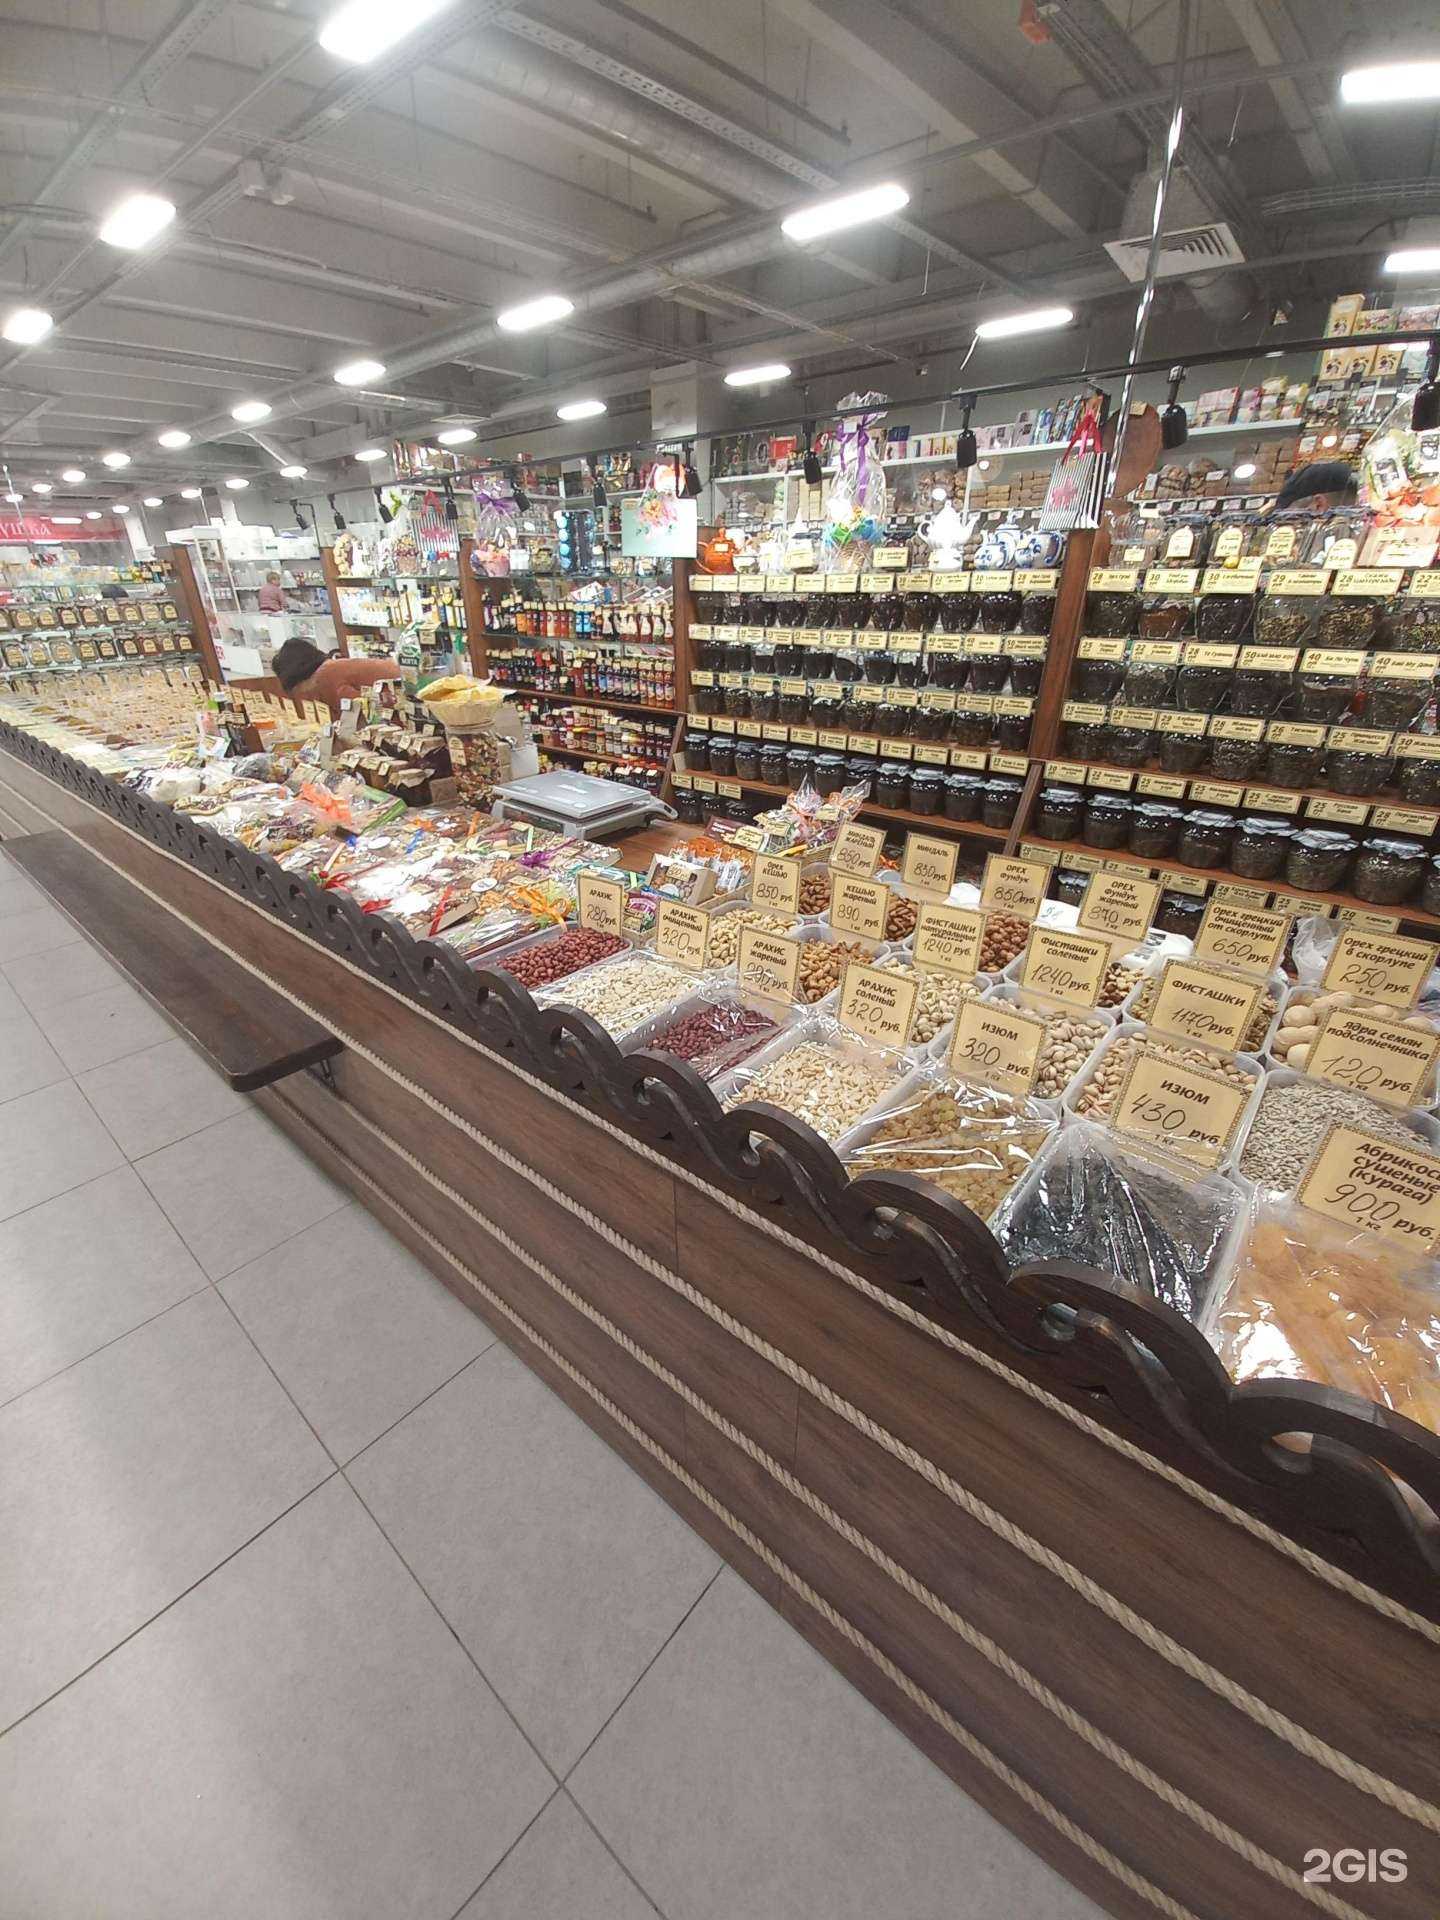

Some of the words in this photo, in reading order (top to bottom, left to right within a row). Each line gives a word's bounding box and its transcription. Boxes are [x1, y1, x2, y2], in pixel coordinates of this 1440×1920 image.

[1272, 574, 1286, 582] 29
[1417, 574, 1431, 582] 22
[1308, 653, 1322, 661] 40
[1400, 738, 1413, 746] 30
[1376, 811, 1391, 819] 28
[762, 868, 788, 880] КЕШЬЮ
[1006, 864, 1027, 875] ОРЕХ
[589, 888, 613, 901] АРАХИС
[756, 883, 779, 900] 850
[780, 894, 793, 904] руб.
[846, 885, 876, 898] КЕШЬЮ
[1111, 880, 1136, 892] ОРЕХ
[1020, 896, 1037, 905] руб.
[586, 903, 607, 924] 280
[670, 908, 698, 923] АРАХИС
[837, 904, 860, 922] 890
[864, 918, 880, 929] руб.
[1123, 917, 1143, 927] руб.
[1213, 906, 1238, 919] Орех
[1240, 911, 1284, 927] грецкий
[925, 917, 977, 935] ФИСТАШКИ
[1207, 922, 1223, 932] от
[1224, 925, 1277, 943] скорлупы
[662, 927, 690, 951] 320
[753, 940, 786, 956] АРАХИС
[922, 938, 951, 955] 1240
[952, 948, 972, 957] руб.
[1040, 936, 1099, 956] Фисташки
[750, 950, 787, 967] жареный
[1046, 947, 1089, 964] соленые
[1212, 938, 1253, 958] 650
[1248, 953, 1271, 965] руб.
[1344, 937, 1375, 951] Орех
[1376, 944, 1428, 962] грецкий
[1346, 948, 1354, 957] в
[1356, 952, 1416, 970] скорлупе
[771, 979, 789, 991] руб.
[1031, 963, 1072, 988] 1240
[1069, 980, 1091, 992] руб.
[1339, 964, 1388, 989] 250
[1384, 982, 1411, 995] руб.
[855, 988, 897, 1008] соленый
[858, 978, 898, 998] АРАХИС
[1172, 980, 1247, 1008] ФИСТАШКИ
[848, 998, 884, 1023] 320
[880, 1020, 901, 1033] руб.
[1169, 1008, 1215, 1029] 1170
[1208, 1022, 1236, 1038] руб.
[981, 1022, 1019, 1041] ИЗЮМ
[1380, 1031, 1424, 1050] семян
[1326, 1026, 1431, 1062] подсолнечника
[959, 1038, 1001, 1067] 320
[1006, 1062, 1031, 1078] руб.
[1322, 1055, 1383, 1085] 120
[1381, 1077, 1413, 1095] руб.
[1160, 1080, 1211, 1105] ИЗЮМ
[1130, 1092, 1186, 1130] 430
[1356, 1143, 1440, 1182] Абрикос
[1353, 1156, 1440, 1194] сушеные
[1348, 1166, 1434, 1206] (курага)
[1324, 1184, 1401, 1222] 900
[1392, 1218, 1437, 1240] руб.
